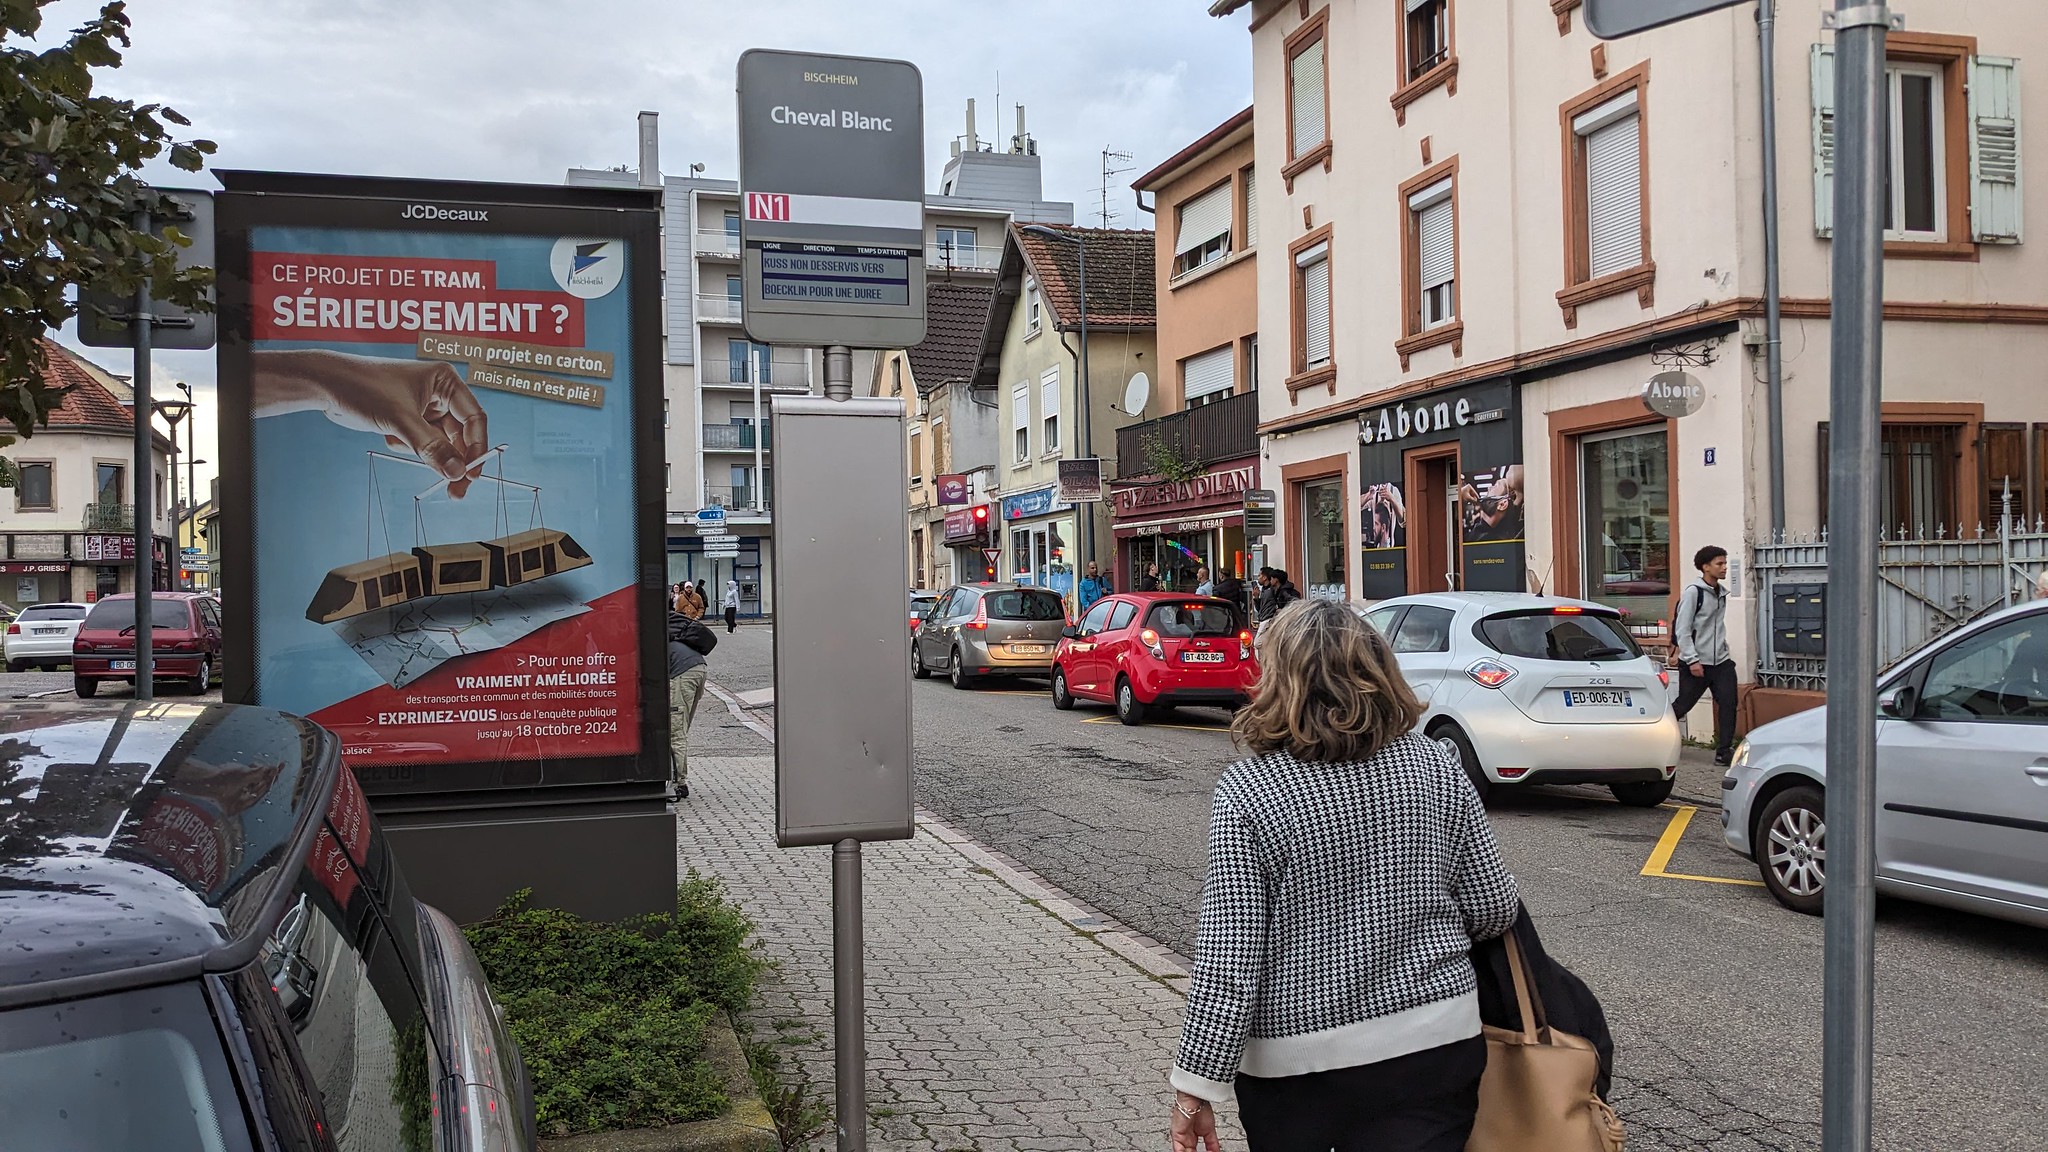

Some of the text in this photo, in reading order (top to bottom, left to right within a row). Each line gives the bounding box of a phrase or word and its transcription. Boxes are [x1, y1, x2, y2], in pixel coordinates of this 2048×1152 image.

[803, 71, 859, 86] BISCHHEIM
[770, 105, 893, 132] Cheval Blanc
[401, 204, 489, 222] JCDecaux
[755, 194, 784, 221] N1
[803, 245, 836, 253] DIRECTION
[857, 247, 877, 255] TEMPS
[877, 248, 908, 256] D'ATTENTE
[764, 257, 885, 274] KUSS NON DESSERVIS VERS
[272, 264, 486, 290] CE PROJET DE TRAM,
[764, 284, 882, 300] BOECKLIN POUR UNE DUREE
[272, 287, 570, 334] SÉRIEUSEMENT ?
[423, 337, 607, 374] C'est un projet en carton,
[473, 368, 503, 386] mais
[505, 373, 531, 390] rien
[533, 379, 565, 396] n'est
[566, 381, 591, 403] plié
[1651, 381, 1700, 398] Abone
[1376, 397, 1470, 443] Abone
[1706, 450, 1713, 462] 8
[1121, 469, 1250, 509] PIZZERIA DILAN
[1178, 518, 1225, 531] DONER KEBAB
[528, 652, 617, 667] Pour une offre
[456, 668, 617, 689] VRAIMENT AMÉLIORÉE
[405, 687, 617, 705] des transports en commun et des mobilités douces
[378, 706, 617, 725] EXPRIMEZ-VOUS lors de l'enquête publique
[476, 721, 617, 740] jusqu'au 18 octobre 2024
